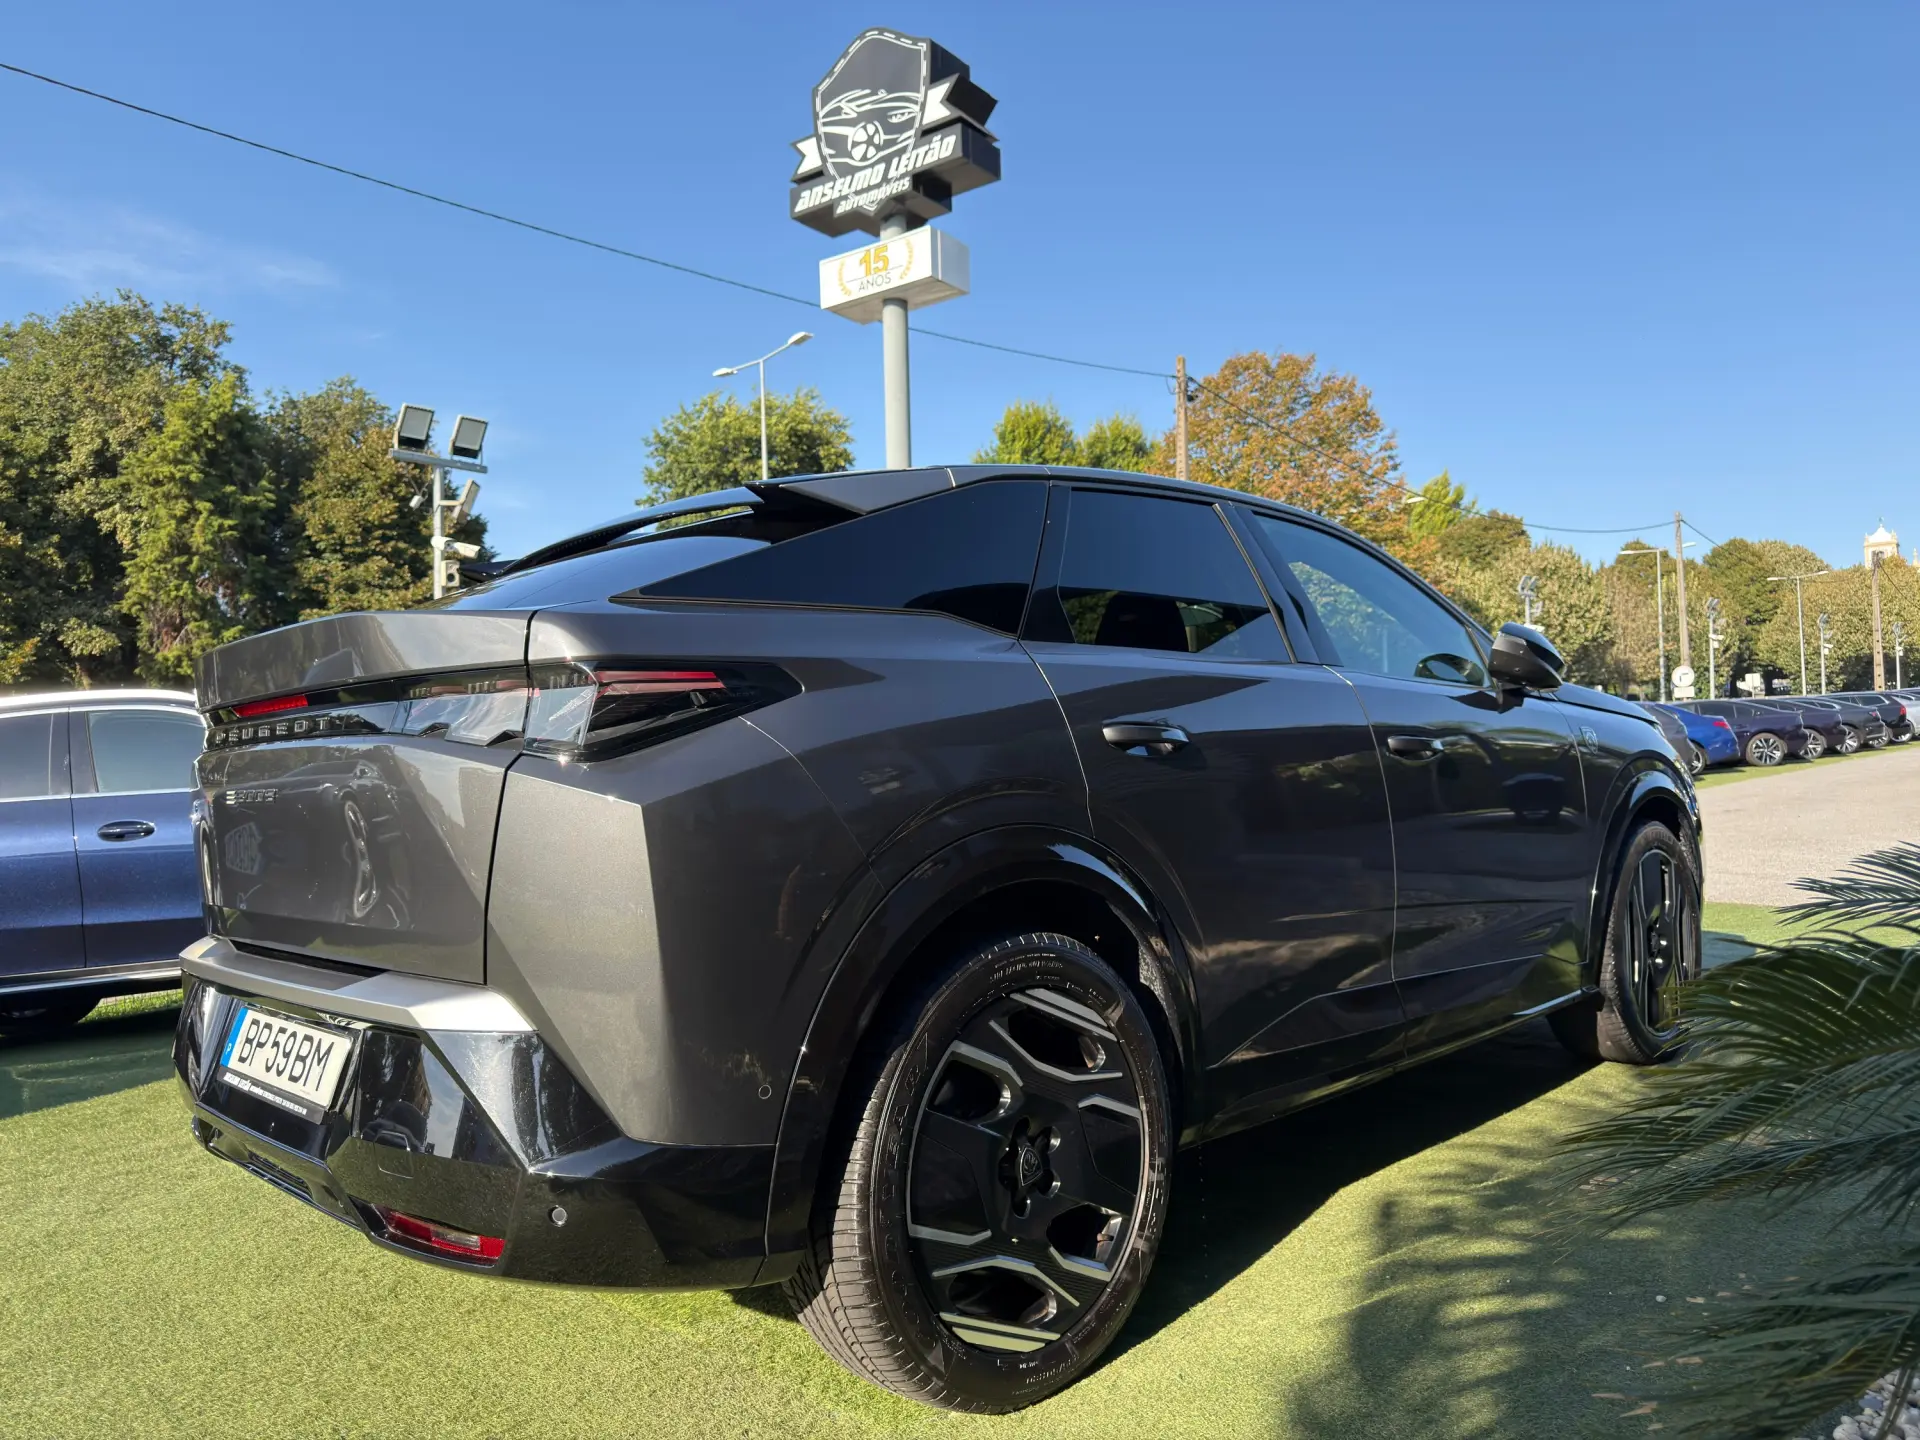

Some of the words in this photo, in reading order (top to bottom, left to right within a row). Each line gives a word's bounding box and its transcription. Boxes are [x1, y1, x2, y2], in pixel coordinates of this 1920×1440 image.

[859, 244, 890, 278] 15
[859, 271, 892, 292] ANOS
[215, 717, 331, 744] PEUGEOT
